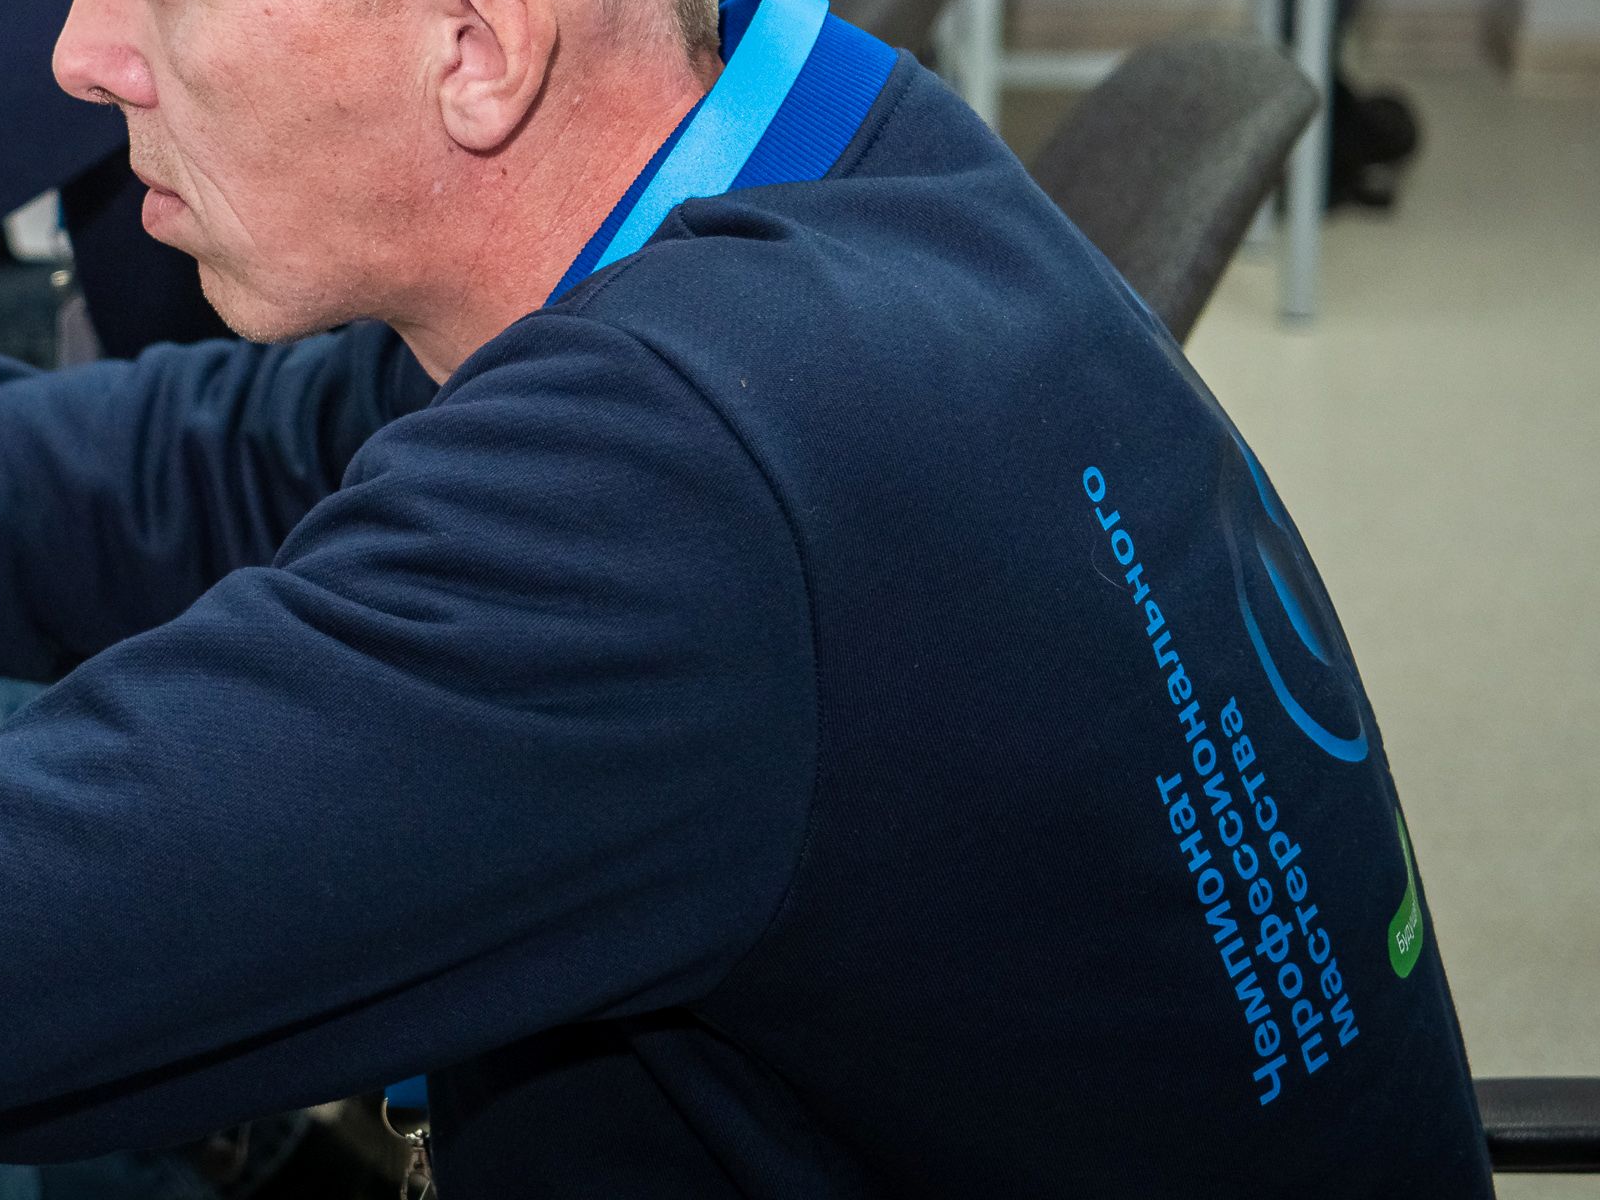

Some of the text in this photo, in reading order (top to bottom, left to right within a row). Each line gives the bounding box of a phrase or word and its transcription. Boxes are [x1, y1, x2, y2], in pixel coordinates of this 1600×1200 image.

[1083, 466, 1329, 1074] профессионального
[1156, 774, 1287, 1105] Чемпионат
[1221, 697, 1359, 1047] мастерства
